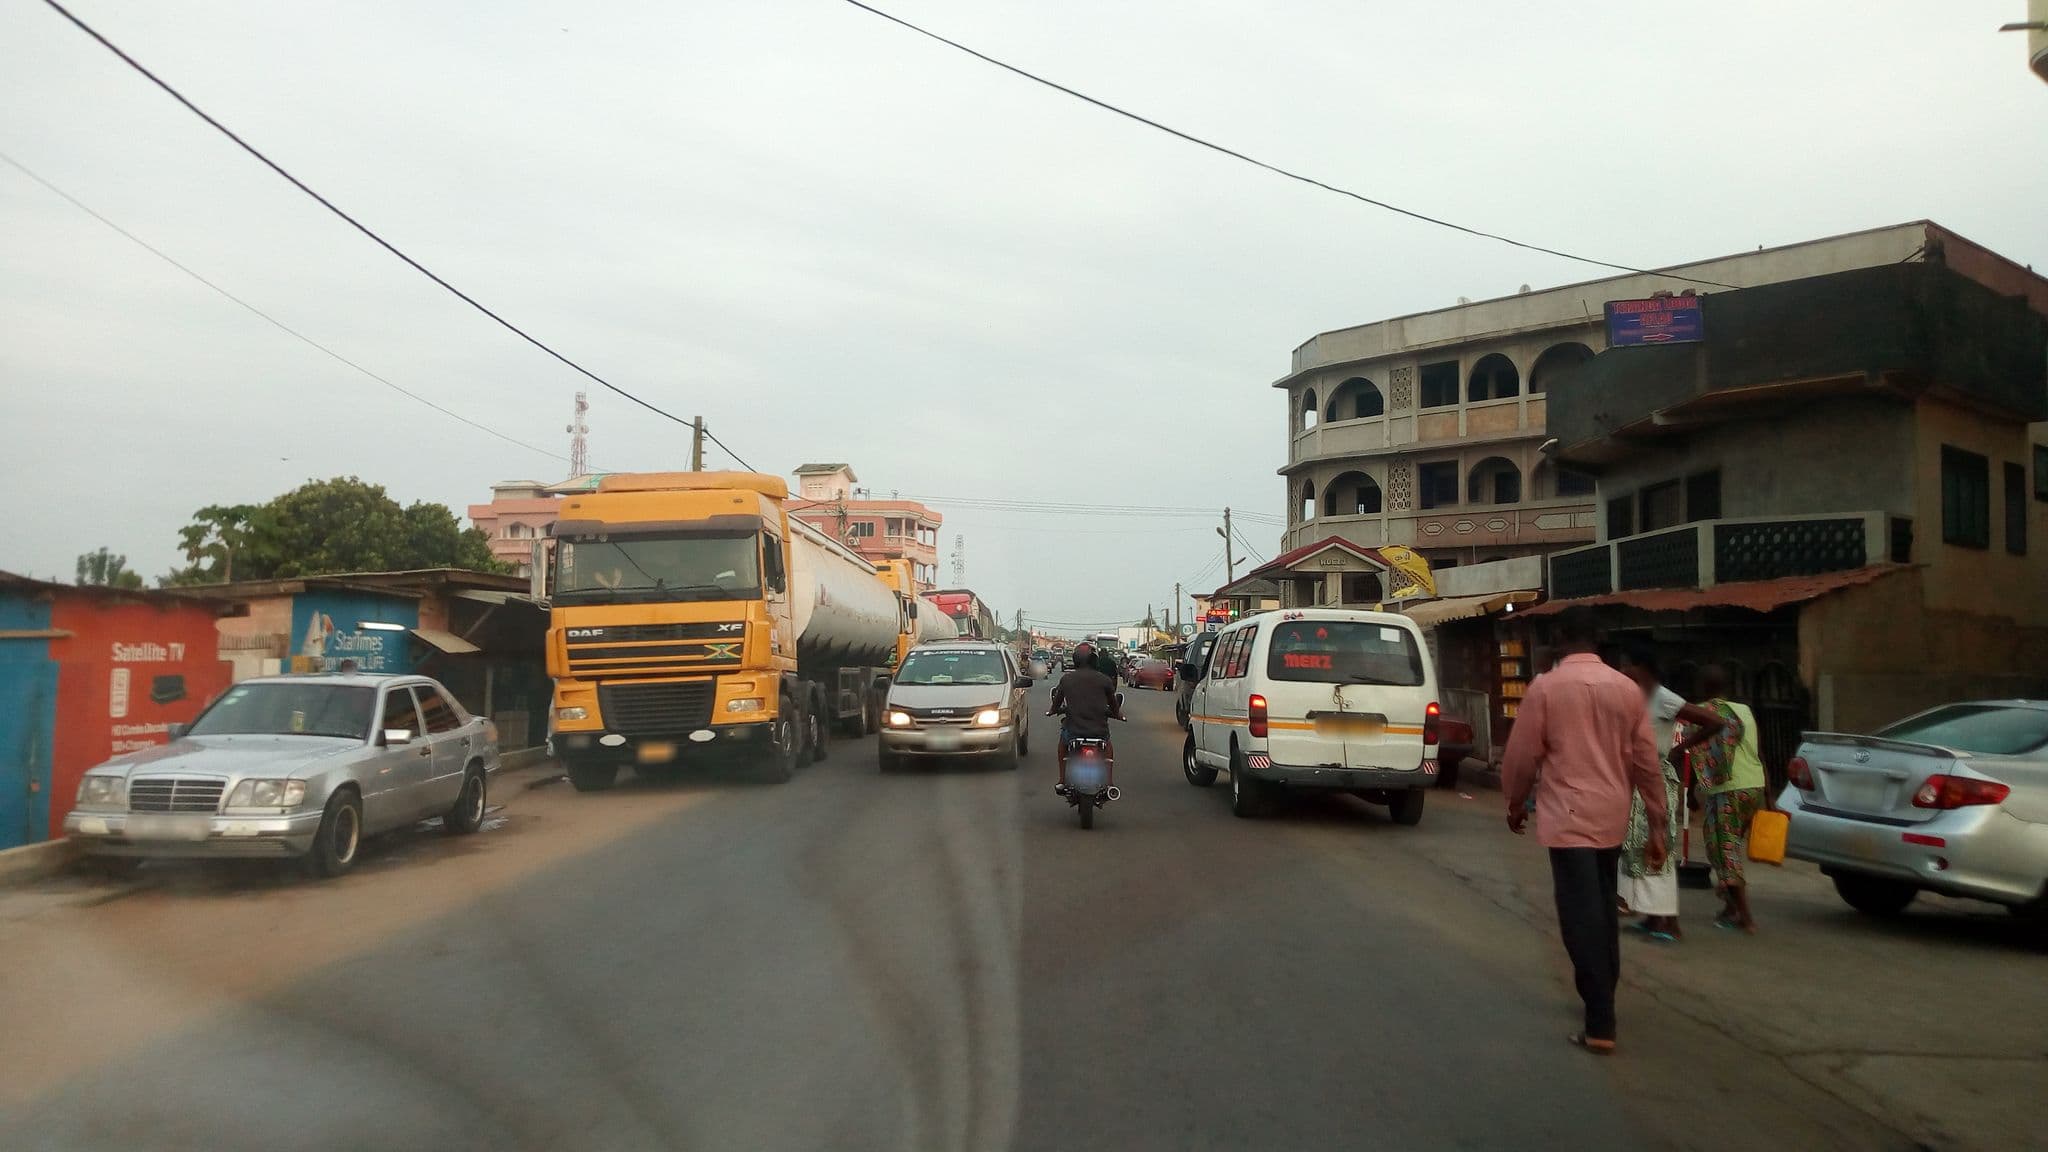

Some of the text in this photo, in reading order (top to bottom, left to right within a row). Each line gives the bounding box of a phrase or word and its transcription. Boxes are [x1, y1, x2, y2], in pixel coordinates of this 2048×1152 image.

[567, 628, 604, 638] DAF
[716, 623, 744, 632] XF
[334, 630, 384, 651] StarTimes
[111, 642, 186, 662] Satellite TV
